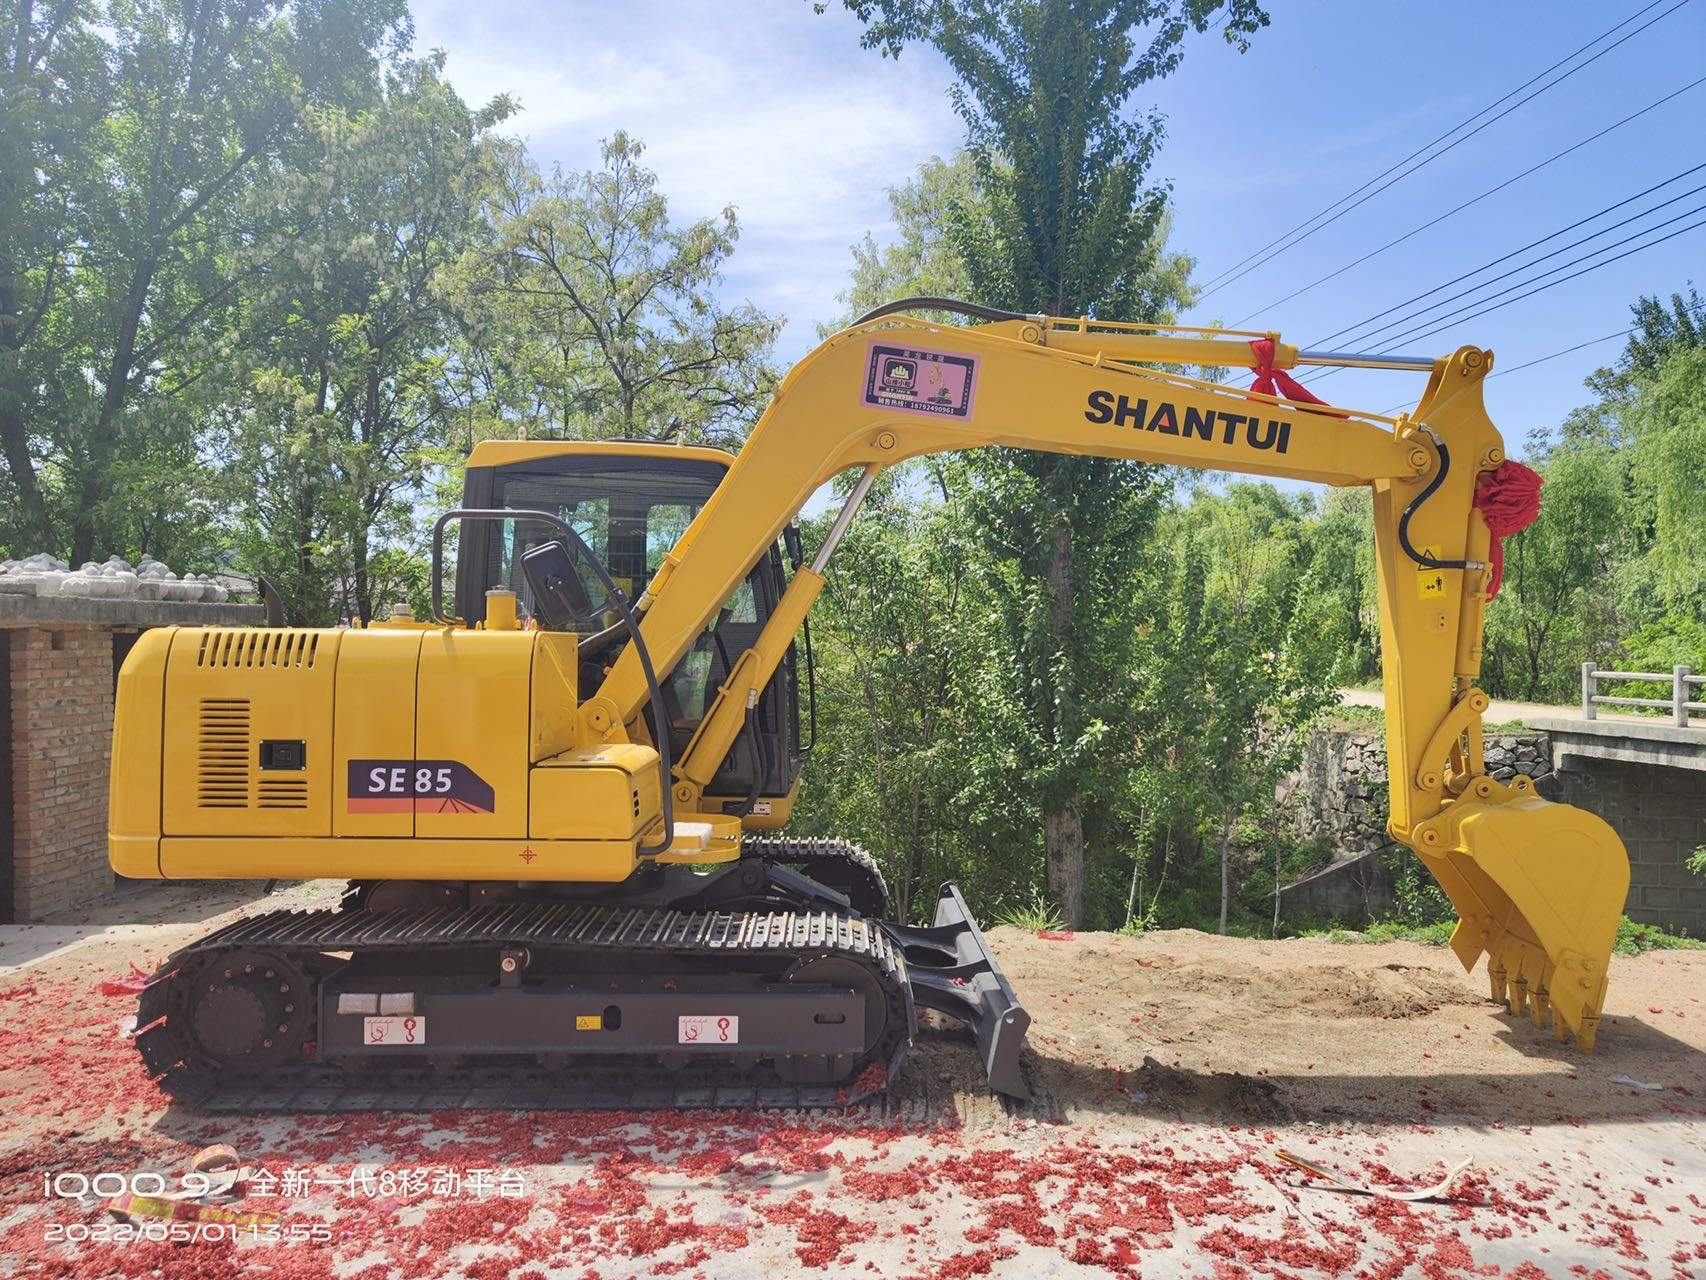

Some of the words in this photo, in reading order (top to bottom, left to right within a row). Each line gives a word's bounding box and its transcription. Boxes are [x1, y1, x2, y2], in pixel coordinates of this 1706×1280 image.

[1084, 390, 1292, 454] SHANTUI
[368, 767, 406, 793] SE
[415, 768, 452, 793] 85
